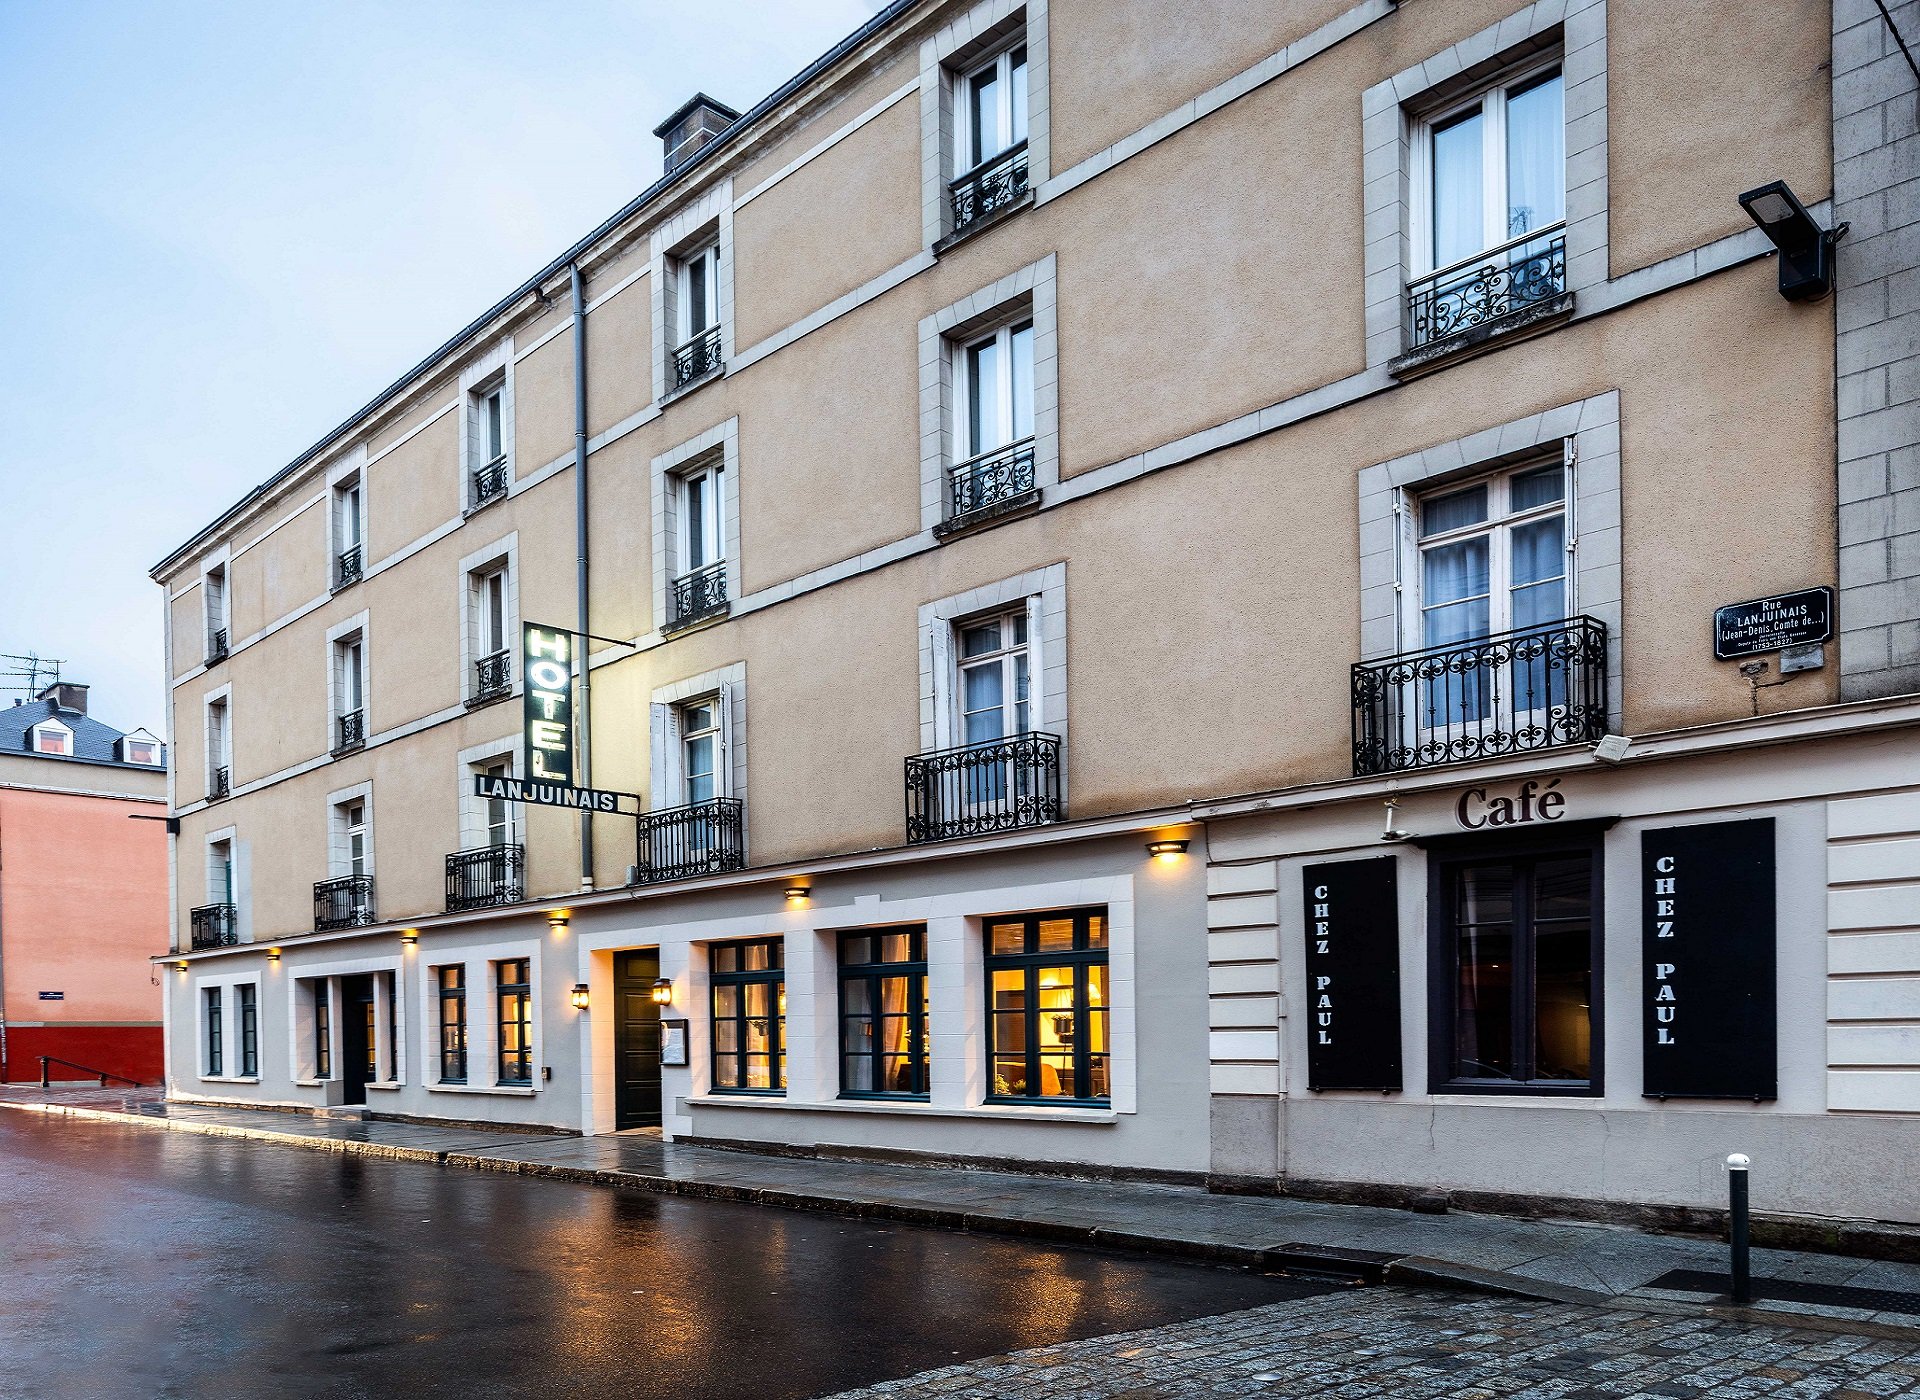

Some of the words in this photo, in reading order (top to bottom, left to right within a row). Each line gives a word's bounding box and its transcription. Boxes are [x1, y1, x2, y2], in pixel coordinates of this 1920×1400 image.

[1737, 605, 1807, 627] LANJUINAIS
[1762, 601, 1781, 611] Rue
[1774, 619, 1799, 631] Comte
[530, 628, 567, 780] HOTEL
[479, 777, 614, 810] LANJUINAIS
[1456, 779, 1565, 829] Café
[1314, 885, 1329, 954] CHEZ
[1655, 856, 1675, 938] CHEZ
[1316, 976, 1332, 1045] PAUL
[1655, 963, 1676, 1045] PAUL
